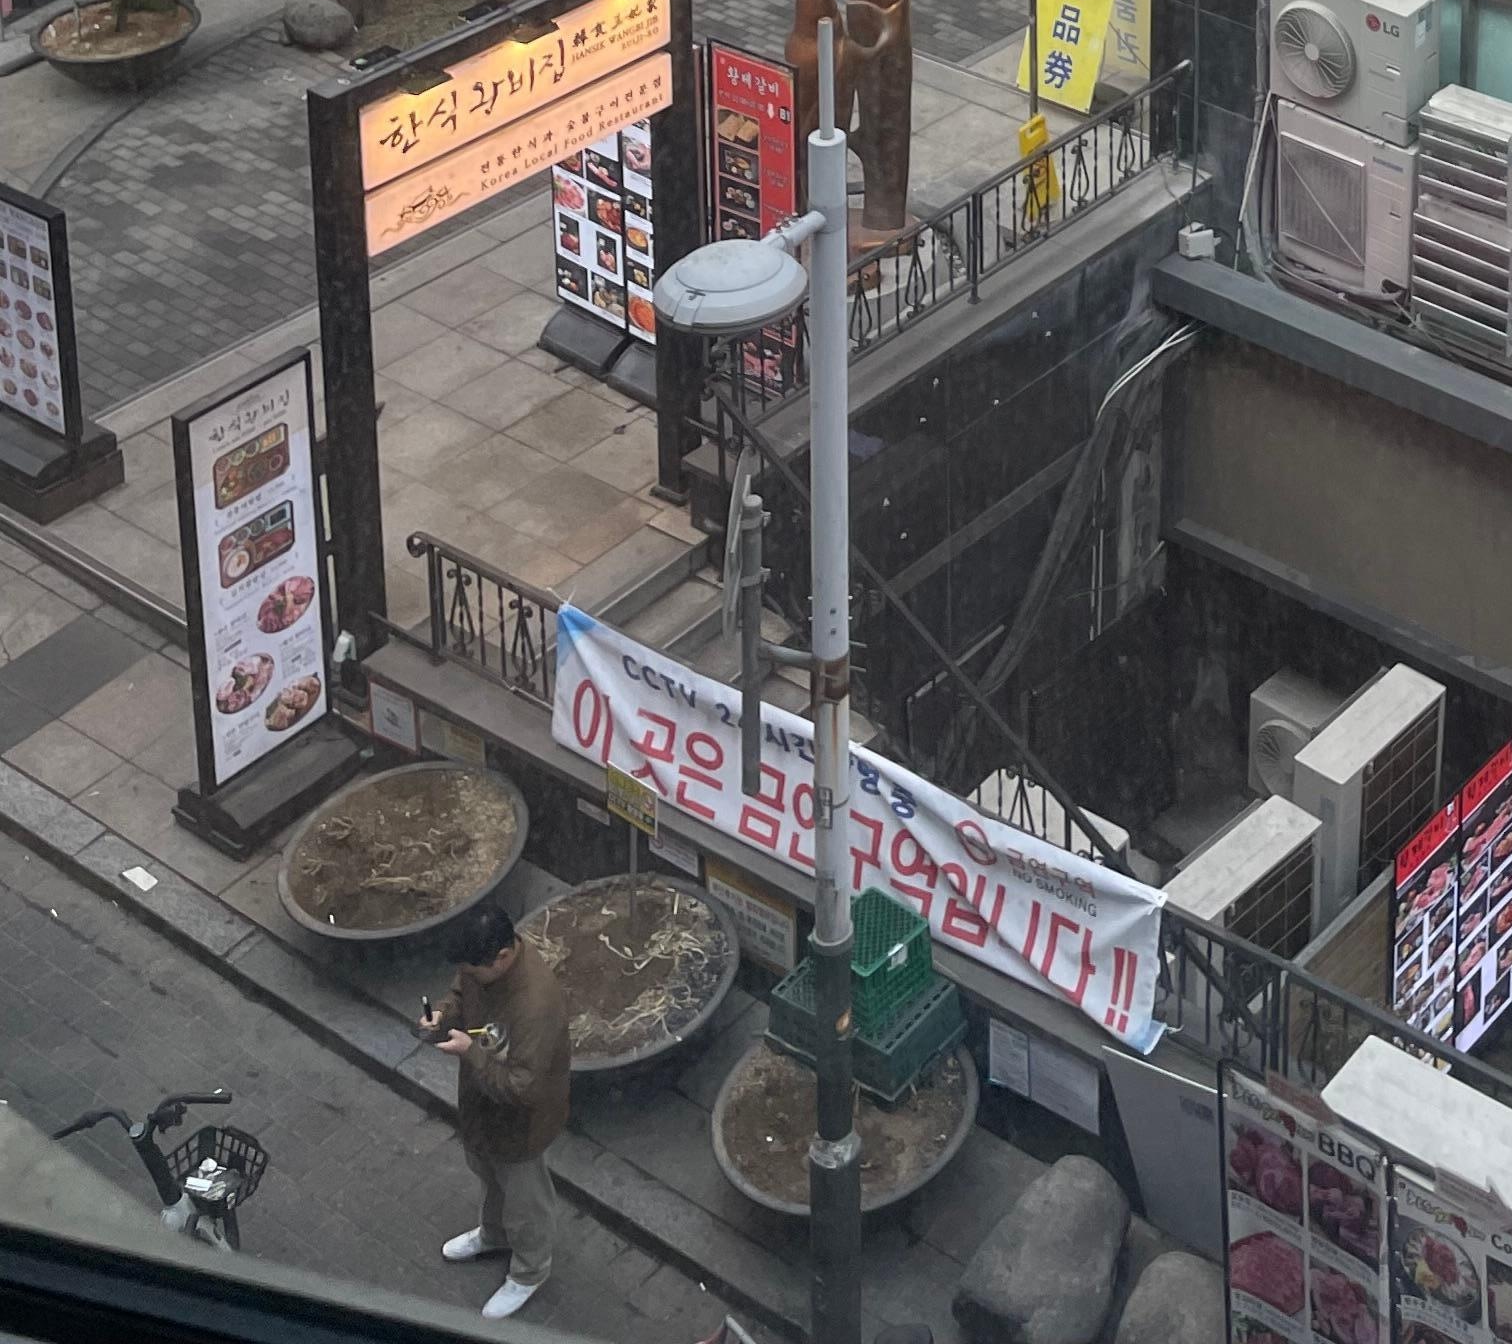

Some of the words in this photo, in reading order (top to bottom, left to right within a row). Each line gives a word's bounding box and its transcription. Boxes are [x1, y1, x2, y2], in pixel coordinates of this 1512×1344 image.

[572, 41, 605, 63] HANSIK
[1382, 21, 1400, 38] LG
[481, 164, 519, 191] Korea
[524, 144, 559, 169] Local
[564, 126, 593, 148] Food
[599, 92, 664, 131] Restaurant
[622, 655, 697, 708] CCTV
[1012, 868, 1032, 883] NO
[1035, 878, 1097, 917] SMOKING
[1318, 1131, 1376, 1182] BBQ
